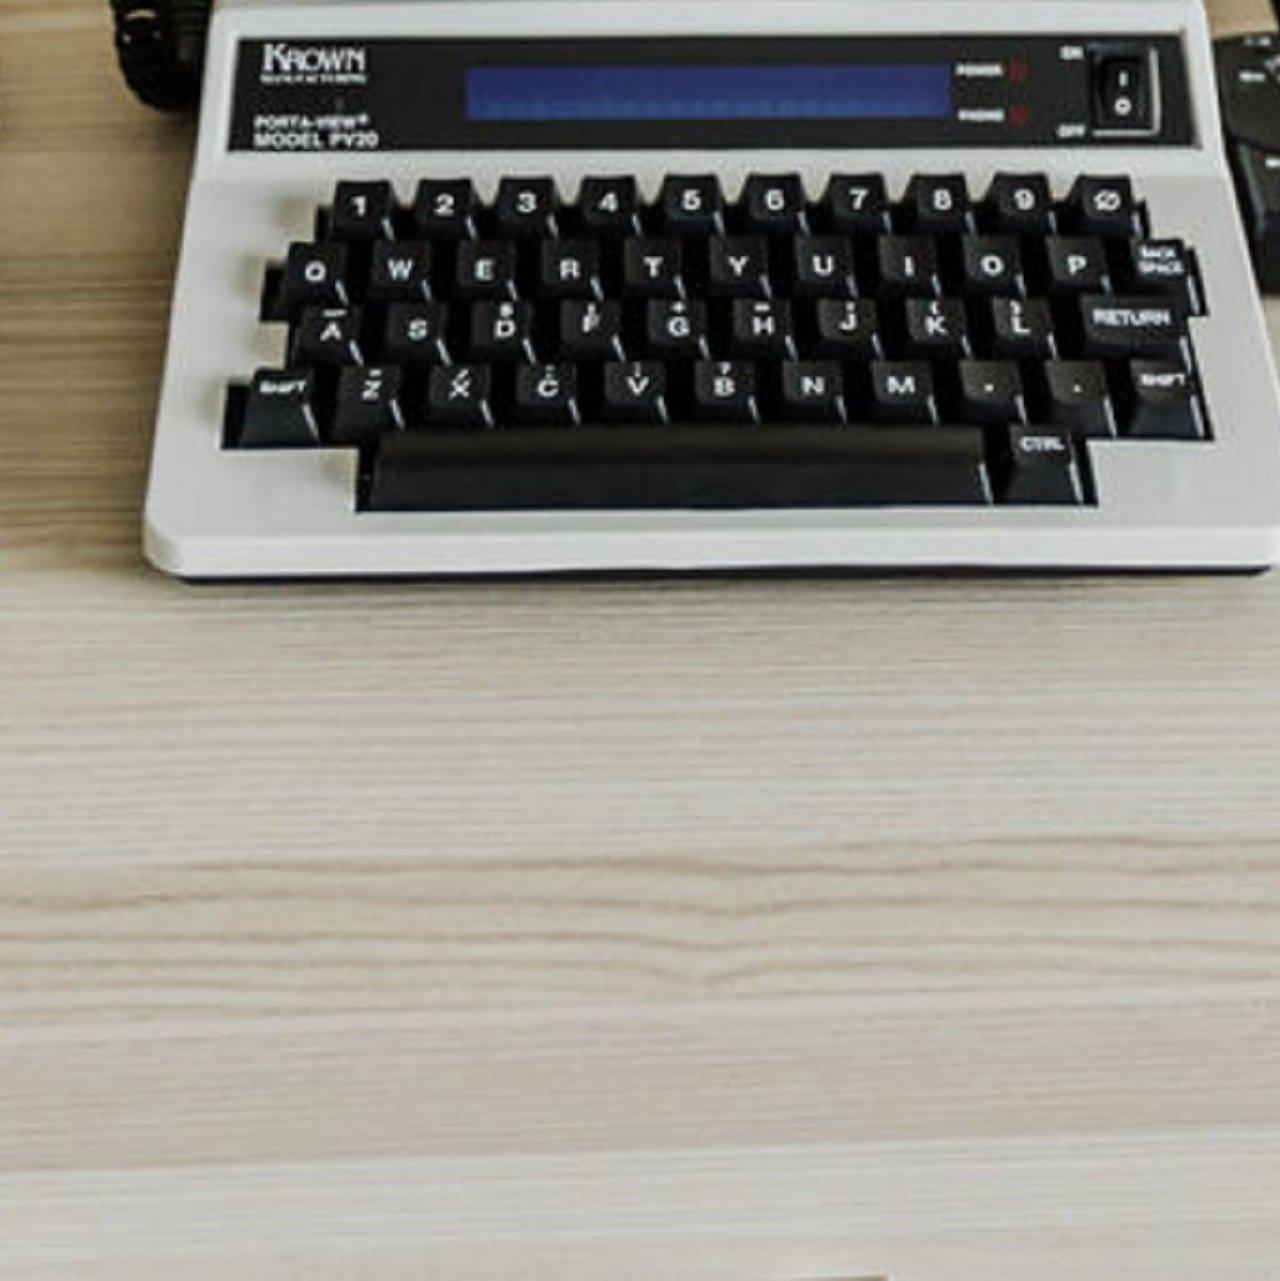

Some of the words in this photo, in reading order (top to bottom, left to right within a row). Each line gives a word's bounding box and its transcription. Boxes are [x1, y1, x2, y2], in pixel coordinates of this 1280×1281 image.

[262, 43, 366, 72] KROWN
[252, 132, 323, 149] MODEL
[353, 195, 366, 216] 1
[434, 193, 455, 216] 2
[517, 192, 537, 213] 3
[599, 192, 618, 212] 4
[682, 189, 702, 211] 5
[764, 189, 785, 211] 6
[849, 188, 868, 210] 7
[933, 188, 952, 211] 8
[1013, 188, 1035, 211] 9
[387, 259, 413, 280] W
[474, 259, 493, 281] E
[643, 256, 663, 277] T
[728, 255, 748, 276] Y
[812, 255, 834, 276] U
[980, 254, 1005, 277] O
[1066, 254, 1087, 276] P
[752, 315, 775, 335] H
[838, 313, 859, 332] J
[925, 315, 950, 335] K
[1011, 312, 1032, 335] L
[1092, 307, 1171, 327] RETURN
[320, 321, 342, 341] A
[408, 319, 427, 340] S
[494, 319, 516, 338] D
[536, 374, 559, 398] C
[627, 374, 649, 396] V
[713, 376, 736, 397] B
[801, 376, 825, 395] N
[886, 375, 916, 395] M
